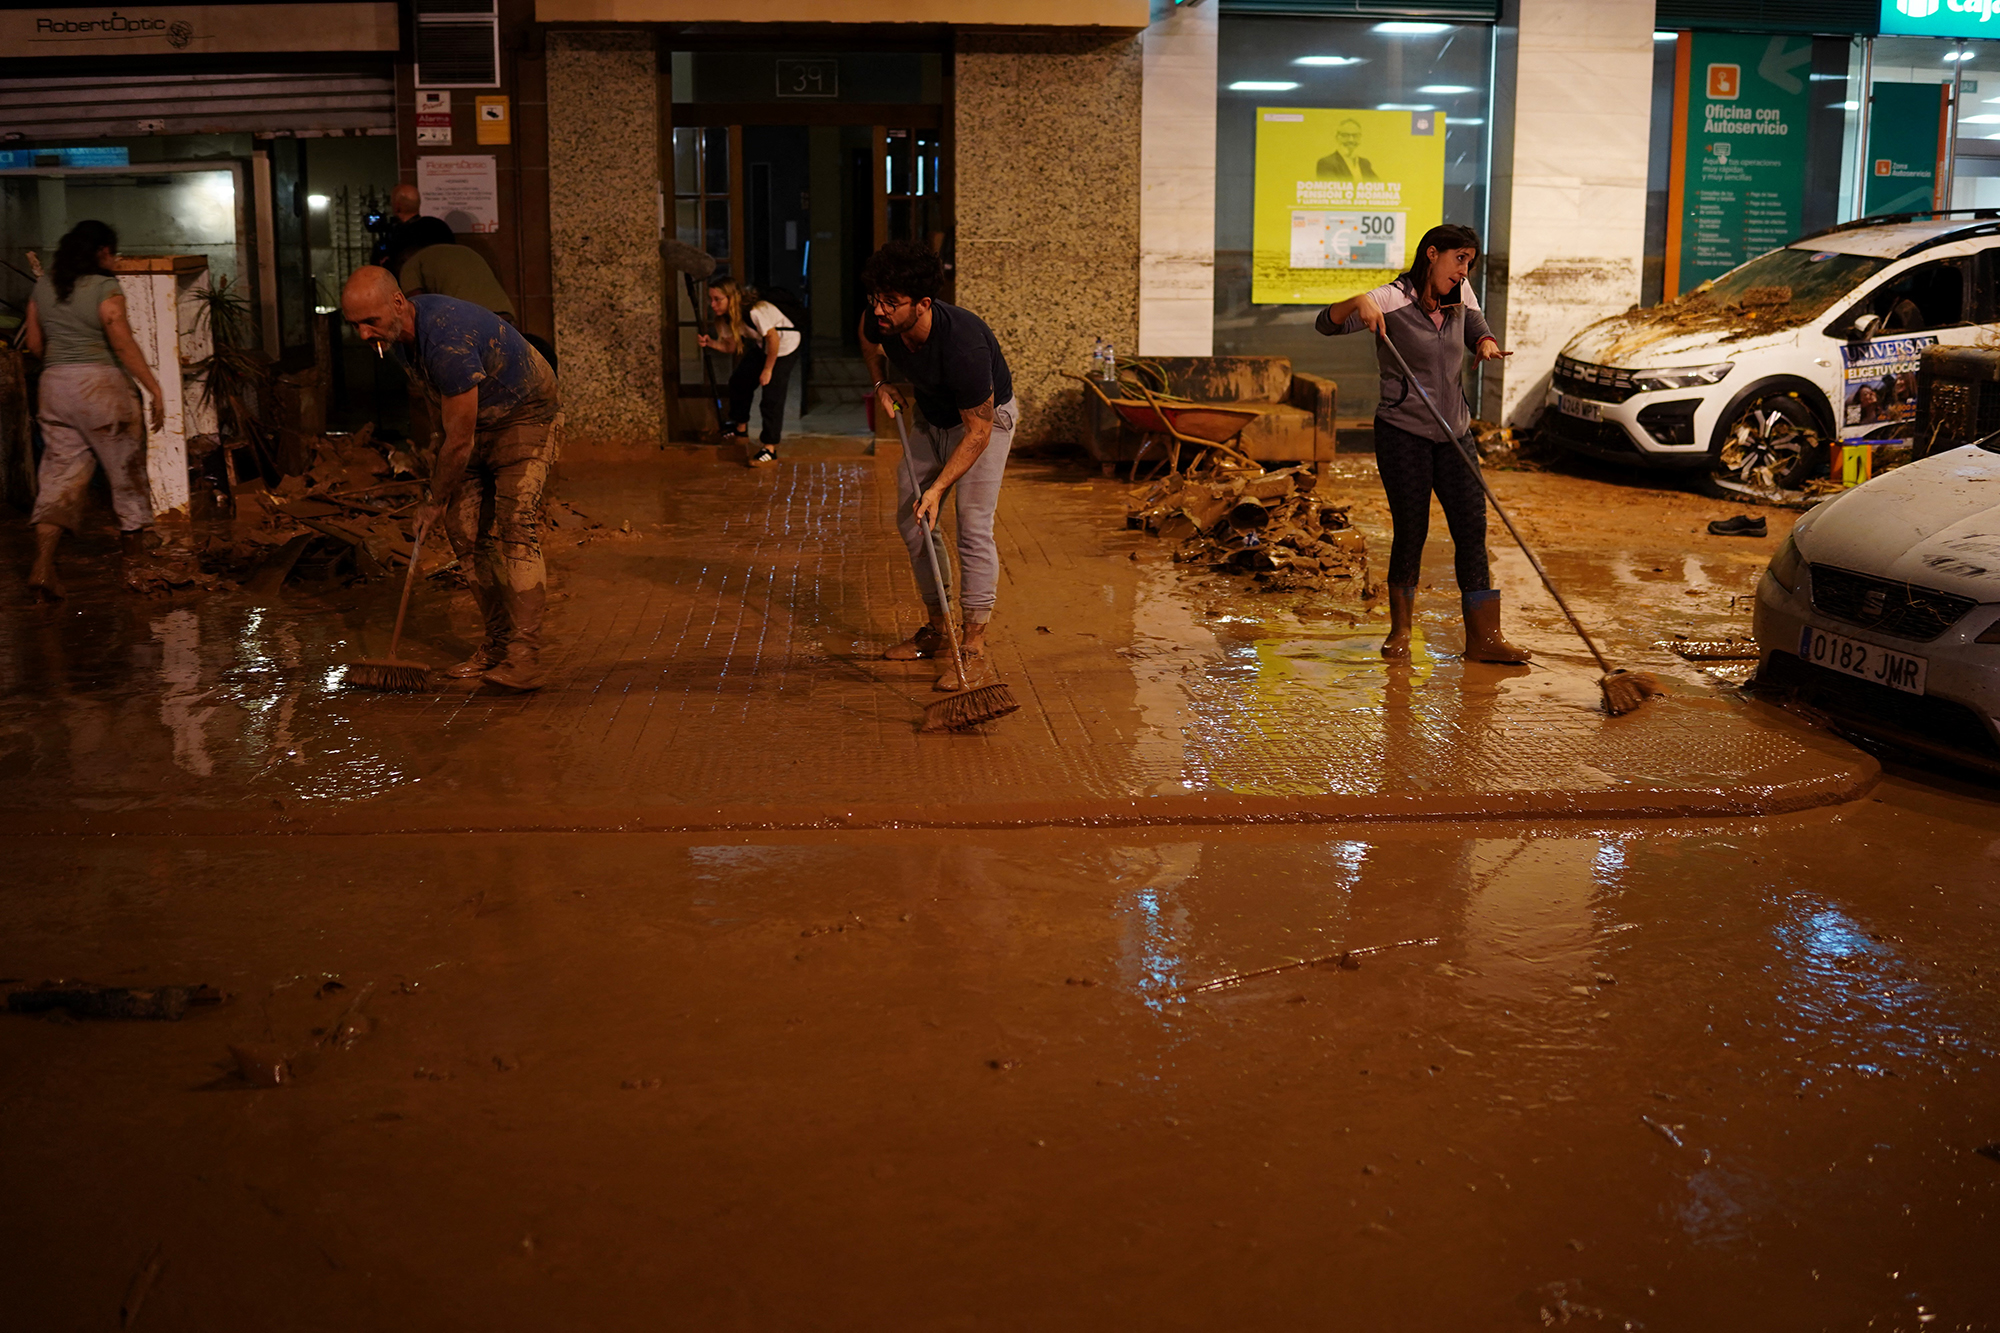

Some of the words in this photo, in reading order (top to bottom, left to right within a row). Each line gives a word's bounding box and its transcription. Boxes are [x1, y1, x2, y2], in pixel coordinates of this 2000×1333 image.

[793, 65, 822, 91] 39
[1705, 104, 1752, 119] Oficina
[1756, 109, 1780, 121] con
[1704, 119, 1788, 135] Autoservicio
[1702, 166, 1718, 174] muy
[1740, 160, 1781, 168] operaciones
[1892, 170, 1931, 178] Autoservicio
[1297, 181, 1354, 191] DOMICILIA
[1387, 183, 1401, 191] TU
[1345, 191, 1354, 199] O
[1360, 216, 1395, 235] 500
[1848, 366, 1875, 379] ELIGE
[1875, 365, 1888, 375] TU
[1888, 361, 1920, 374] VOCAC
[1814, 635, 1867, 674] 0182
[1875, 653, 1919, 689] JMR
